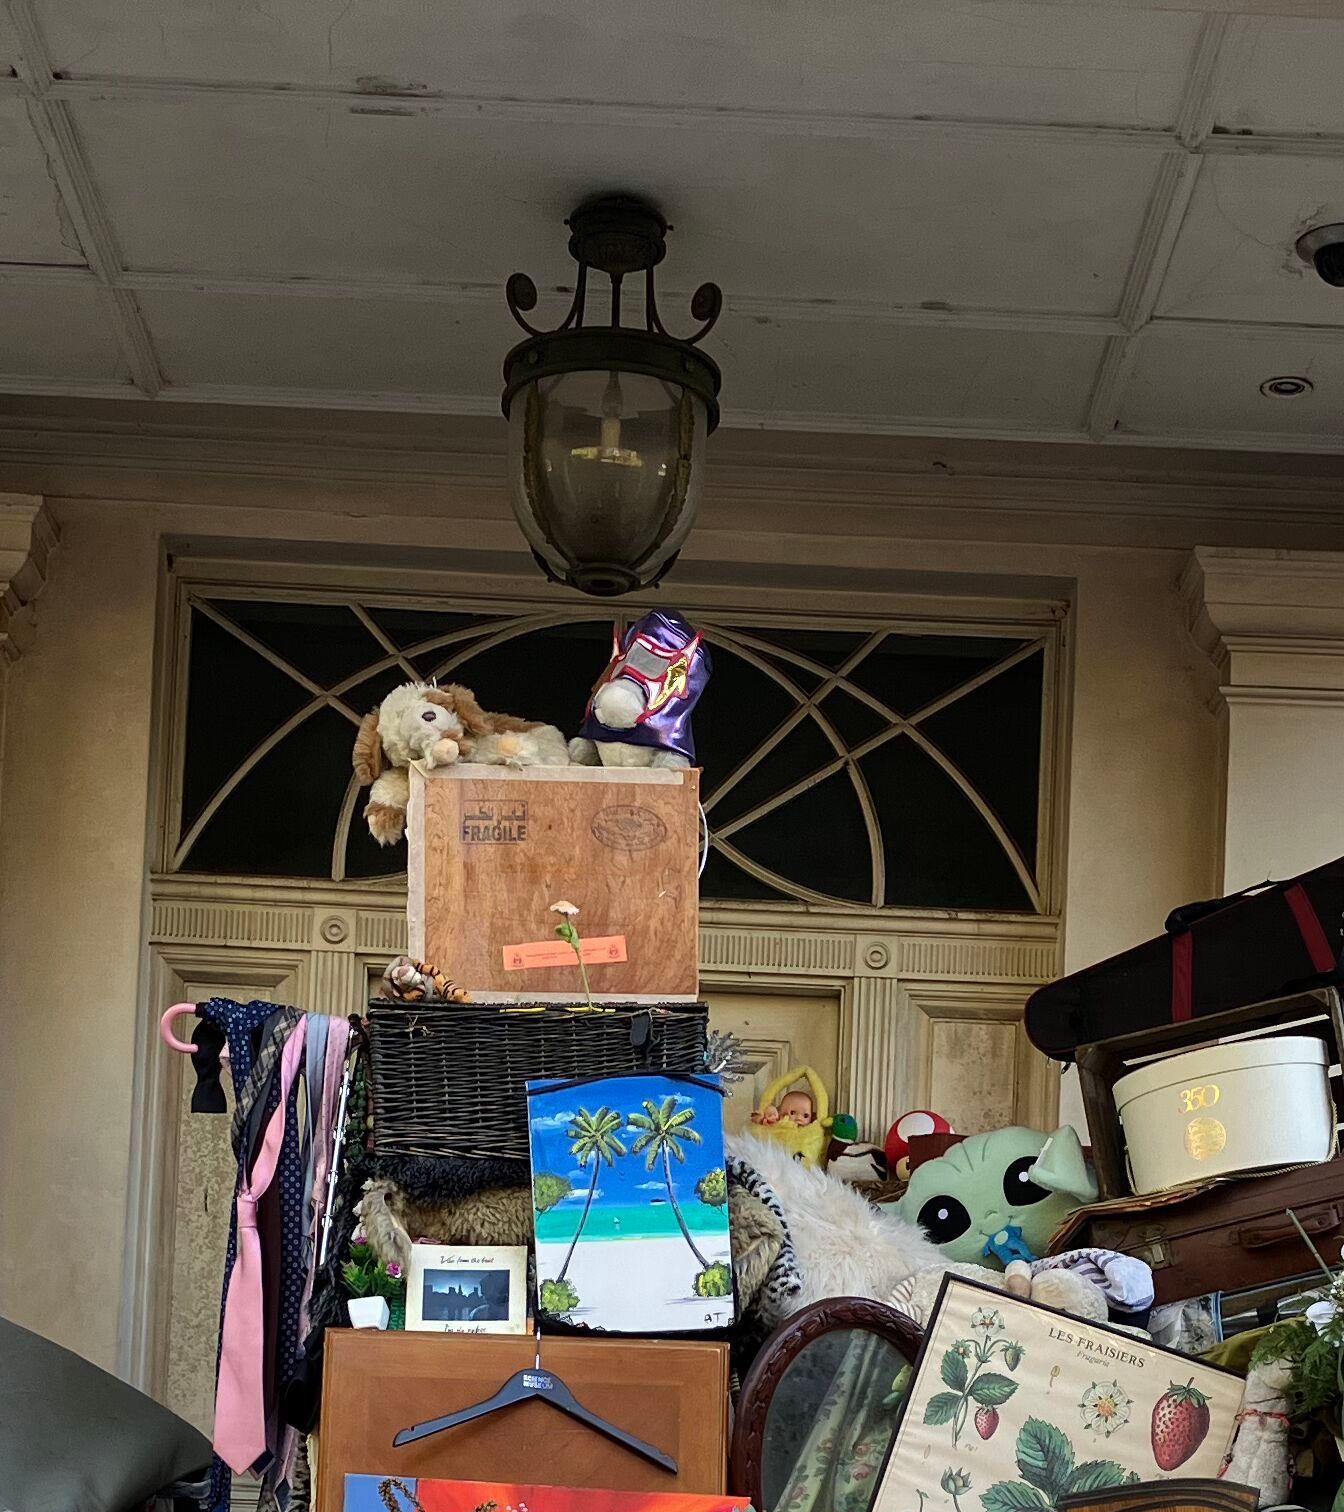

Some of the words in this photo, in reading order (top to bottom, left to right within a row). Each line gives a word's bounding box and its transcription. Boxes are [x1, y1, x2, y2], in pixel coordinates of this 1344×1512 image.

[462, 825, 526, 842] FRAGILE
[1048, 1328, 1073, 1344] LES
[1077, 1337, 1145, 1368] FRAISIERS
